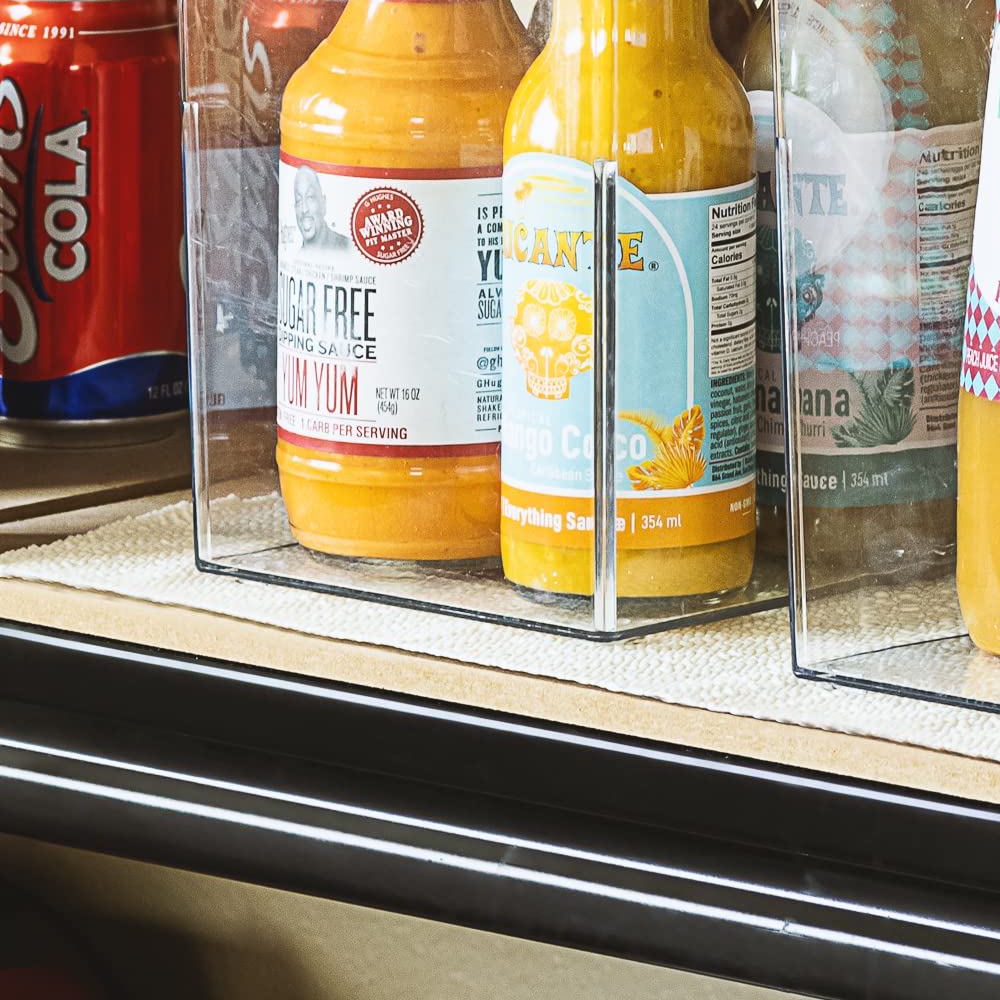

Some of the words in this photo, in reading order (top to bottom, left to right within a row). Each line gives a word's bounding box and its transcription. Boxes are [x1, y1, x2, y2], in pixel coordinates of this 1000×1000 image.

[0, 22, 37, 38] SINCE
[43, 26, 74, 39] 1991
[45, 120, 88, 282] COLA
[364, 208, 404, 229] AWARD
[477, 206, 488, 220] IS
[712, 201, 751, 220] Nutrition
[359, 215, 413, 239] WINNING
[477, 223, 482, 234] A
[365, 237, 378, 247] PIT
[380, 228, 413, 243] MASTER
[711, 251, 743, 265] Calories
[323, 284, 377, 342] FREE
[980, 352, 998, 372] JUICE
[282, 352, 307, 409] YUM
[313, 360, 358, 416] YUM
[376, 387, 388, 400] NET
[389, 387, 400, 400] WT
[402, 387, 409, 400] 16
[411, 387, 420, 400] OZ
[332, 423, 353, 438] PER
[356, 425, 408, 440] SERVING
[801, 473, 838, 490] auce
[641, 514, 663, 530] 354
[666, 513, 682, 528] ml
